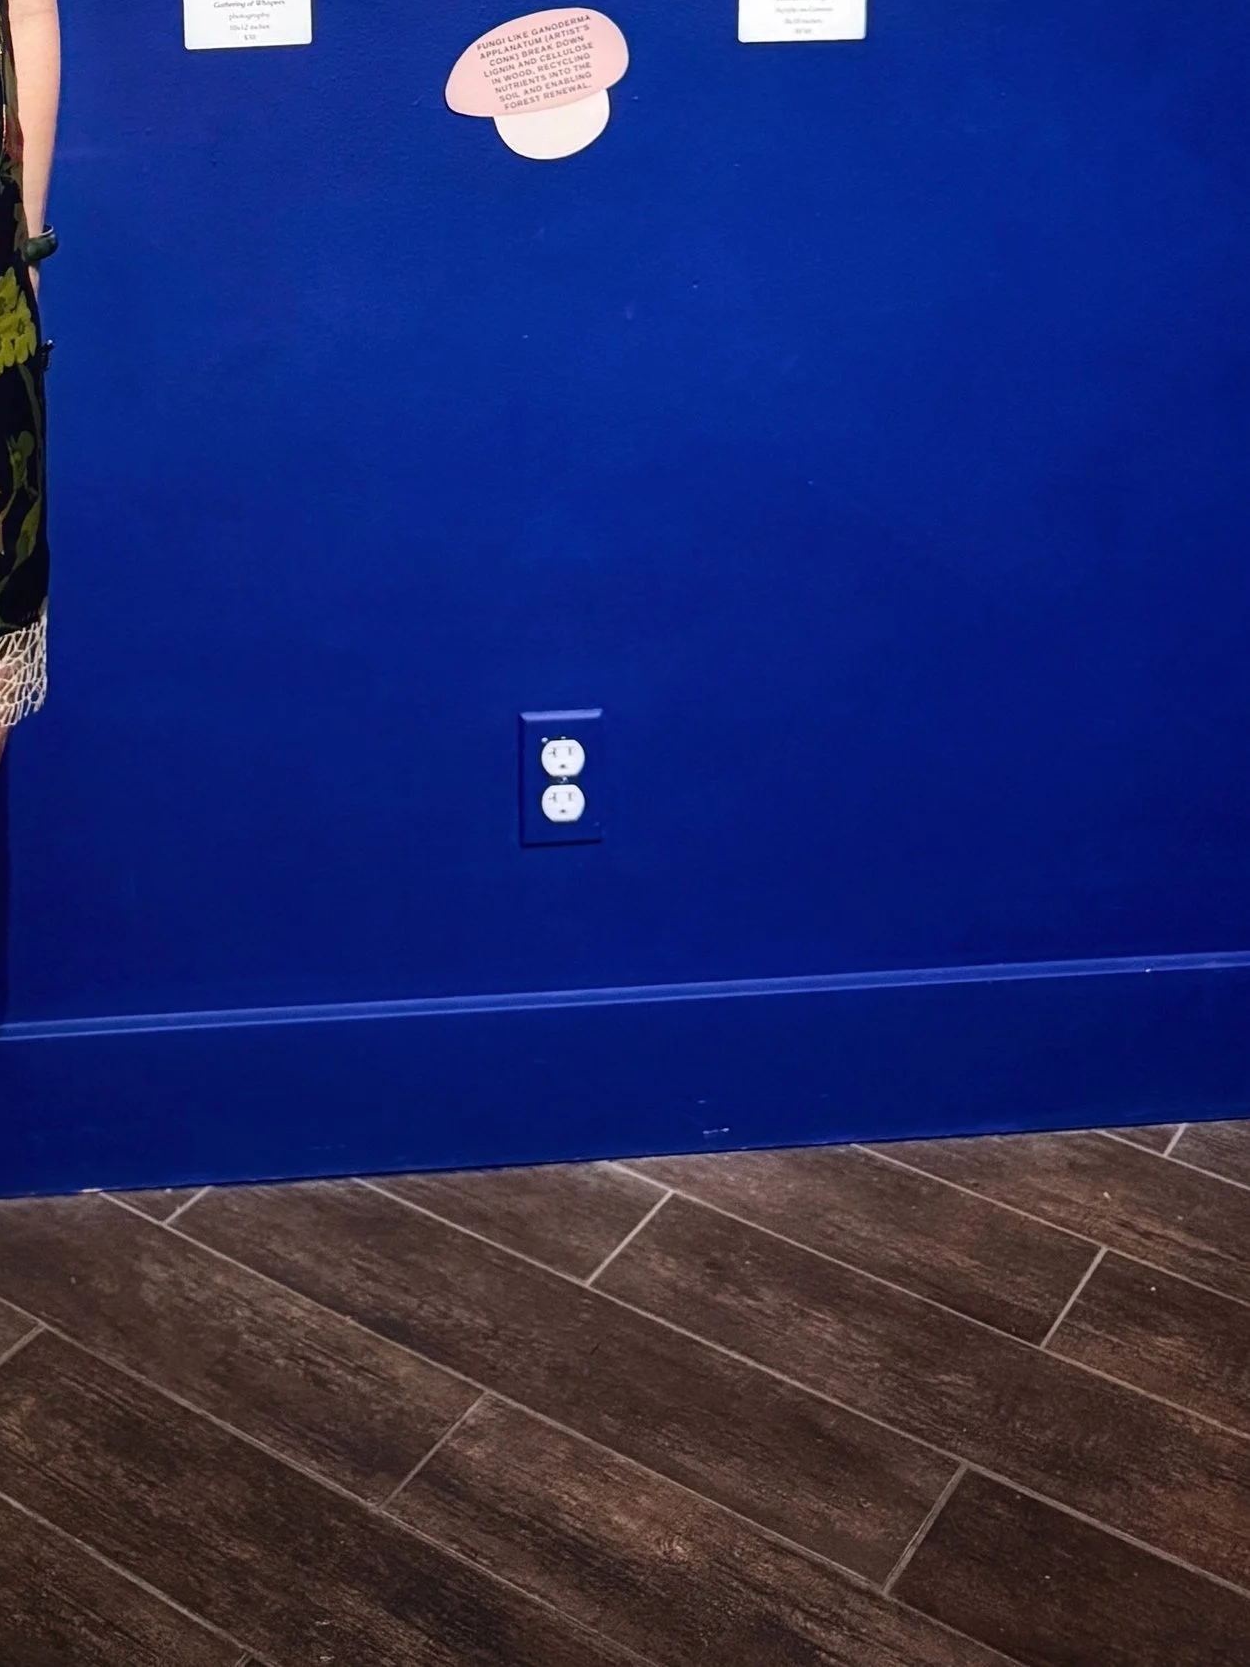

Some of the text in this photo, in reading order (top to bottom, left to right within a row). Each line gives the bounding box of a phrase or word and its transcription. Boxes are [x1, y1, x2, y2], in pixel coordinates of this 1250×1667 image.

[477, 15, 590, 51] FUNGI LIKE GANODERMA
[480, 37, 542, 59] APPLANATUM
[484, 42, 594, 78] LIGNIN AND CELLULOSE
[489, 35, 584, 66] CONK) BREAK DOWN
[492, 77, 501, 85] IN
[537, 53, 590, 72] RECYCLING
[495, 62, 592, 93] NUTRIENTS INTO THE
[499, 72, 592, 102] SOIL AND ENABLING
[504, 96, 540, 110] FOREST
